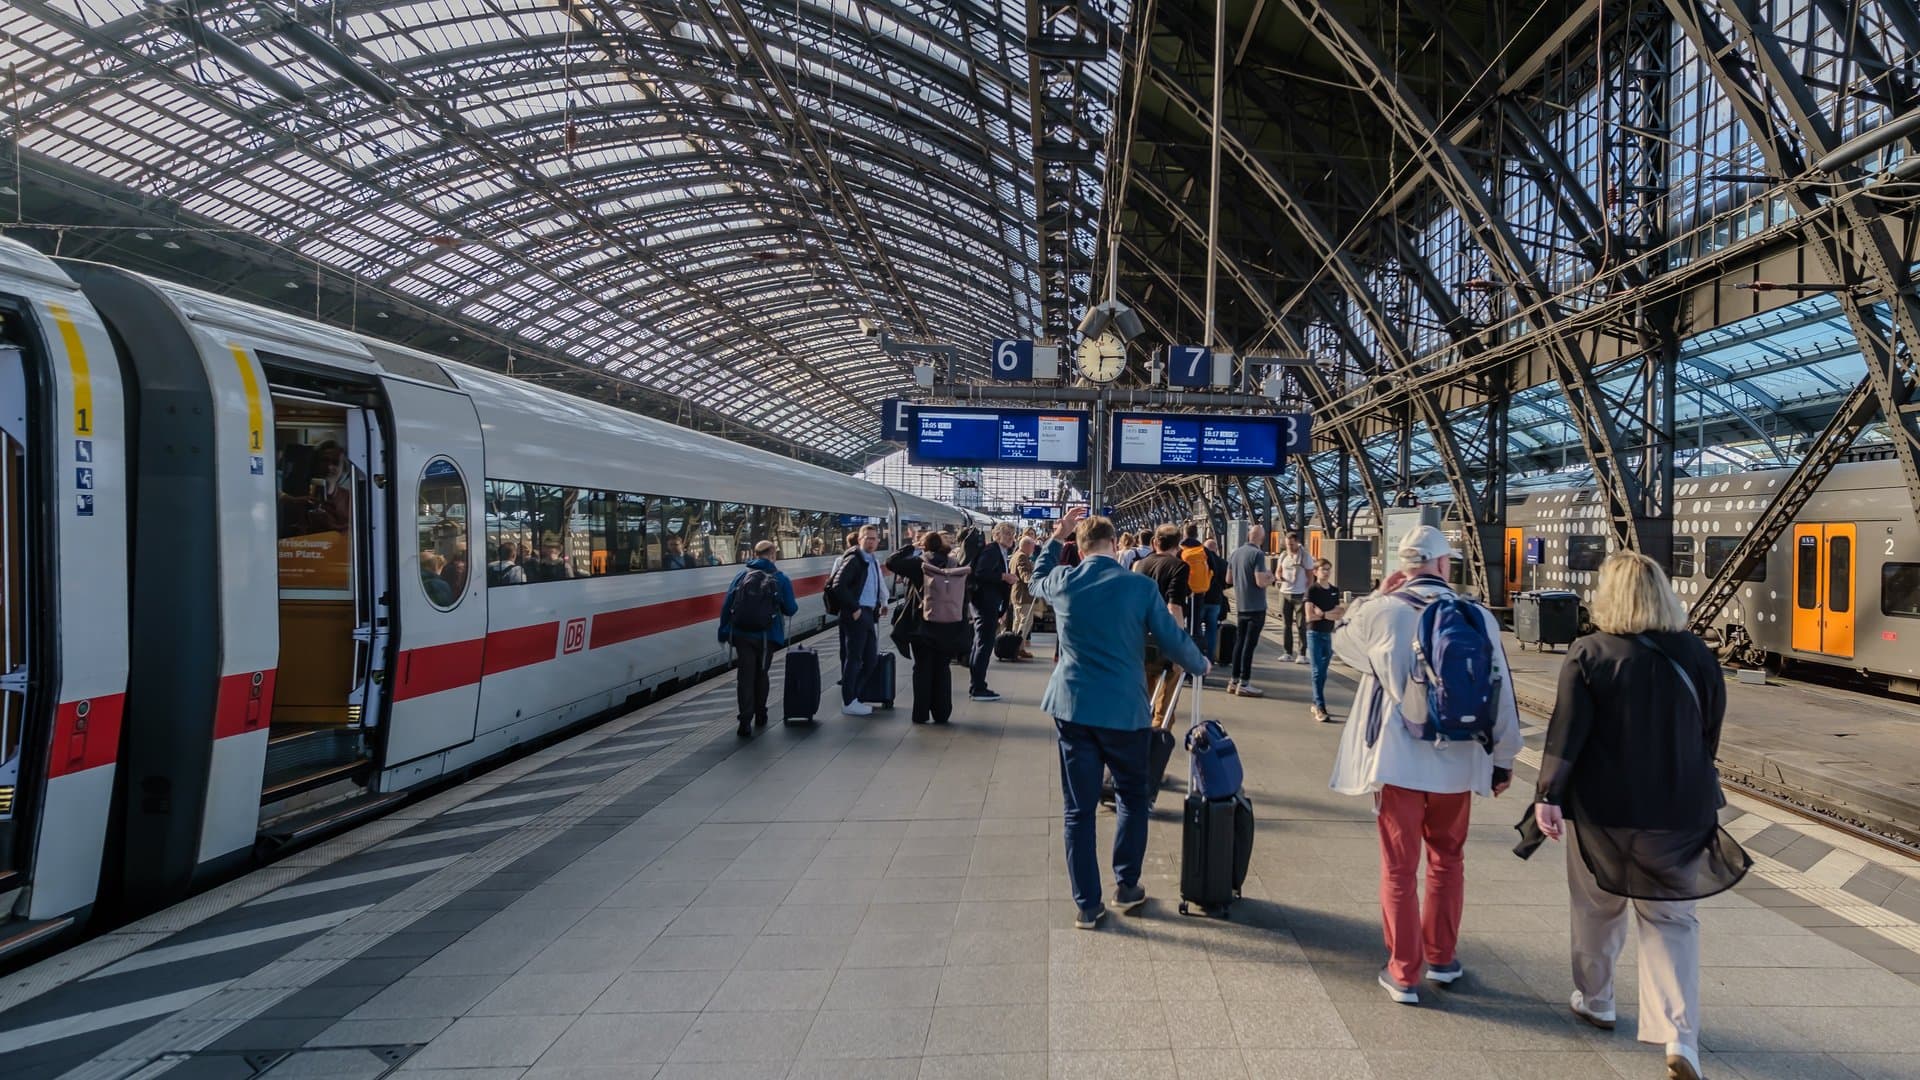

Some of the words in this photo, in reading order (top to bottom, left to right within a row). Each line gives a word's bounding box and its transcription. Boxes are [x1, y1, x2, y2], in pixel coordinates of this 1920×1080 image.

[998, 340, 1018, 371] 6
[1186, 347, 1205, 377] 7
[77, 408, 90, 432] 1
[251, 430, 261, 449] 1
[1885, 538, 1895, 556] 2
[566, 622, 584, 650] DB
